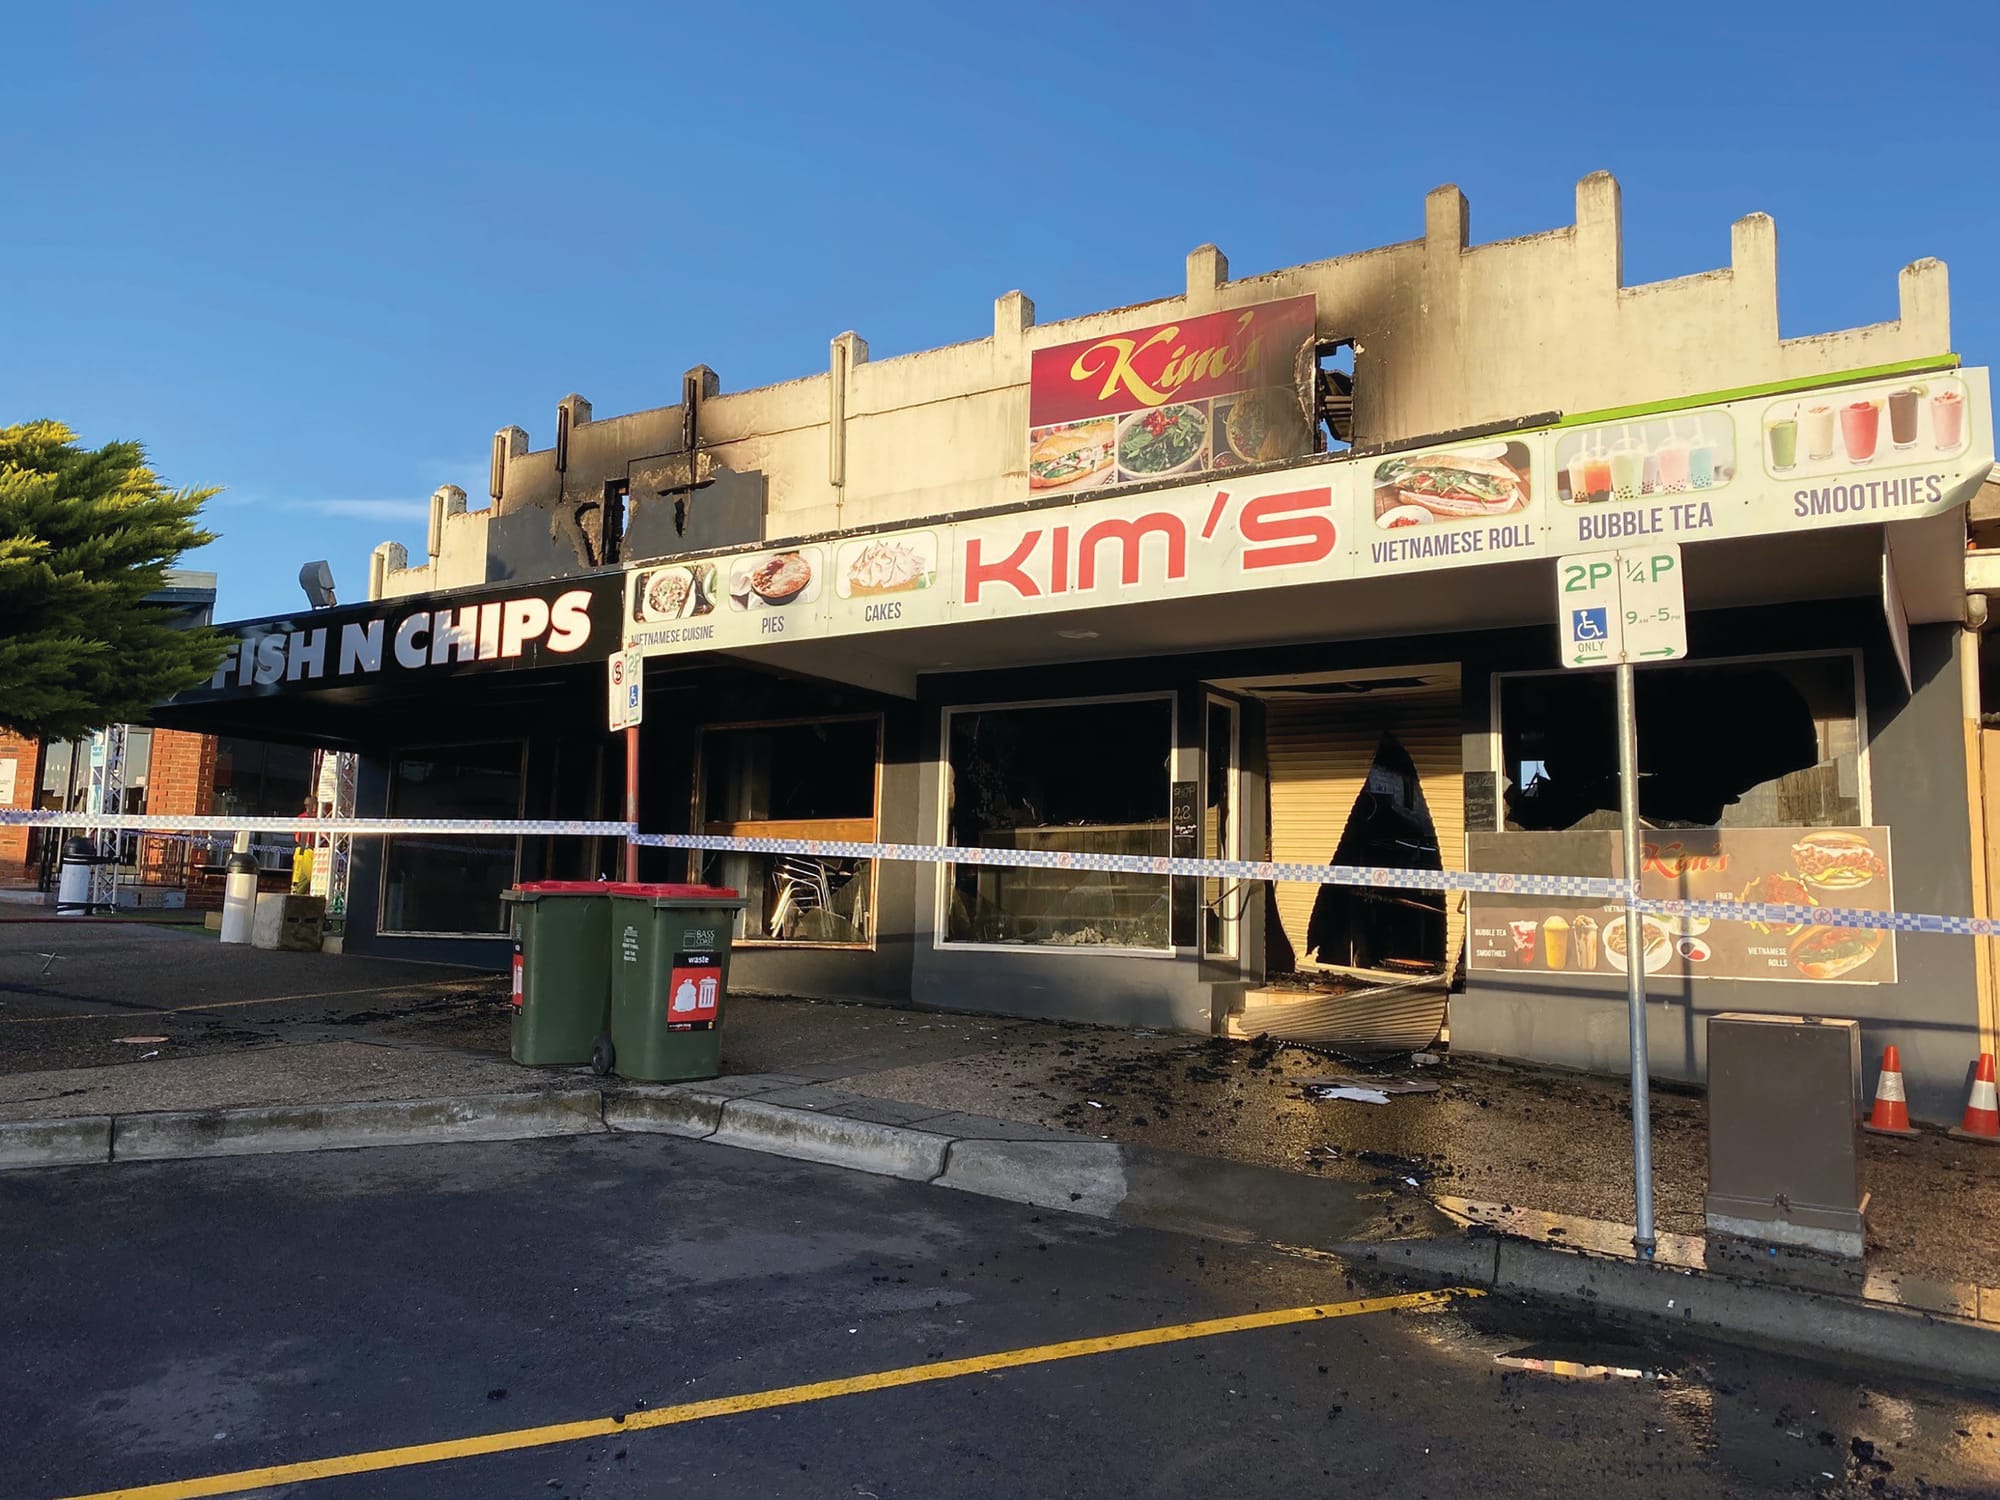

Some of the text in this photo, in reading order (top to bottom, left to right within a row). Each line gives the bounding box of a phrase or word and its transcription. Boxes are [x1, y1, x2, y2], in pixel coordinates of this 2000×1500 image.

[1070, 311, 1264, 406] Kim's
[1793, 474, 1943, 518] SMOOTHIES
[1578, 501, 1713, 541] BUBBLE TEA
[1371, 524, 1535, 564] VIETNAMESE ROLL
[1564, 562, 1612, 592] 2P
[865, 602, 901, 622] CAKES
[761, 616, 784, 634] PIES
[211, 590, 592, 689] FISH N CHIPS
[631, 625, 714, 646] VIETNAMESE CUISINE
[1577, 641, 1605, 653] ONLY
[628, 653, 641, 678] 2P
[1174, 805, 1191, 820] 28
[1715, 892, 1733, 900] FRIED
[1474, 928, 1507, 937] BUBBLE TEA
[687, 956, 710, 964] waste
[1475, 949, 1507, 958] SMOOTHIES
[1748, 946, 1787, 956] VIETNAMESE
[1768, 959, 1787, 967] ROLLS
